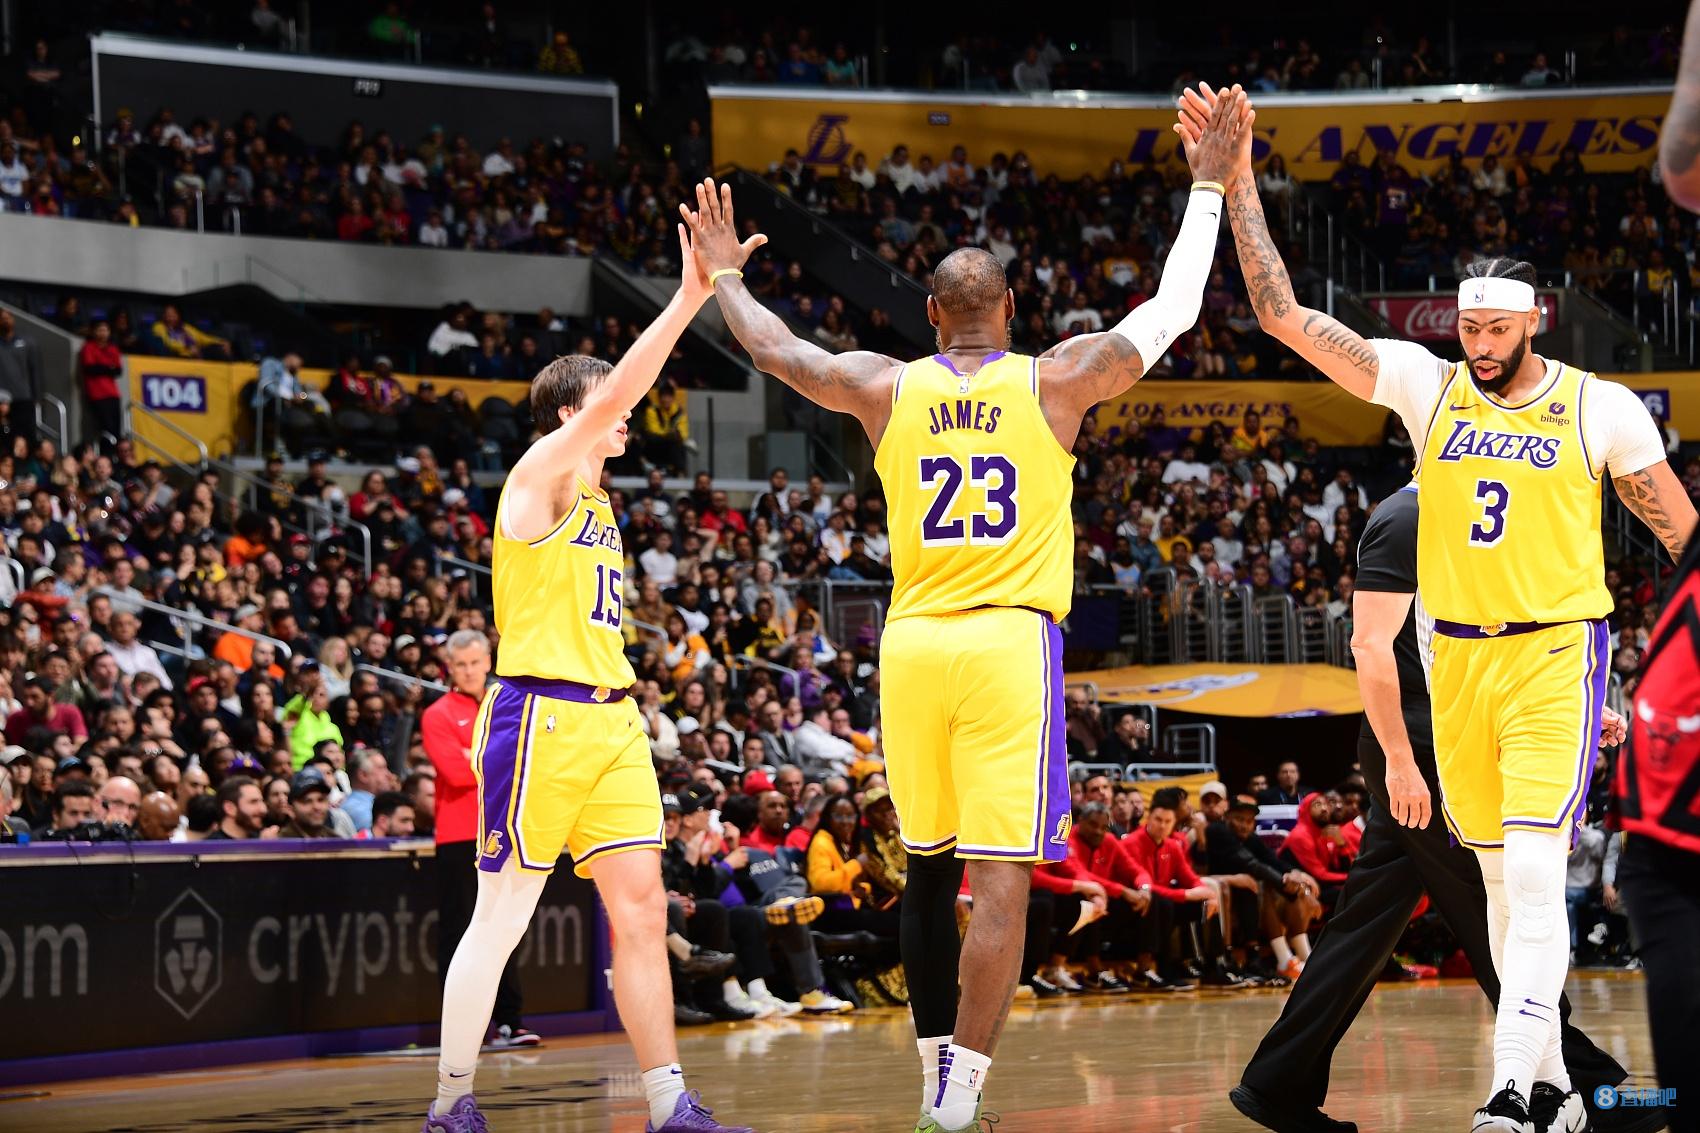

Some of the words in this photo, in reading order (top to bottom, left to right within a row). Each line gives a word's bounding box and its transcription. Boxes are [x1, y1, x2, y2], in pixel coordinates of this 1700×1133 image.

[146, 378, 203, 410] 104
[928, 399, 1002, 435] JAMES
[1437, 419, 1562, 469] LAKERS
[1540, 414, 1570, 427] bibigo
[920, 455, 1018, 545] 23
[1469, 479, 1510, 545] 3
[569, 509, 622, 553] LAKE
[589, 563, 623, 630] 15
